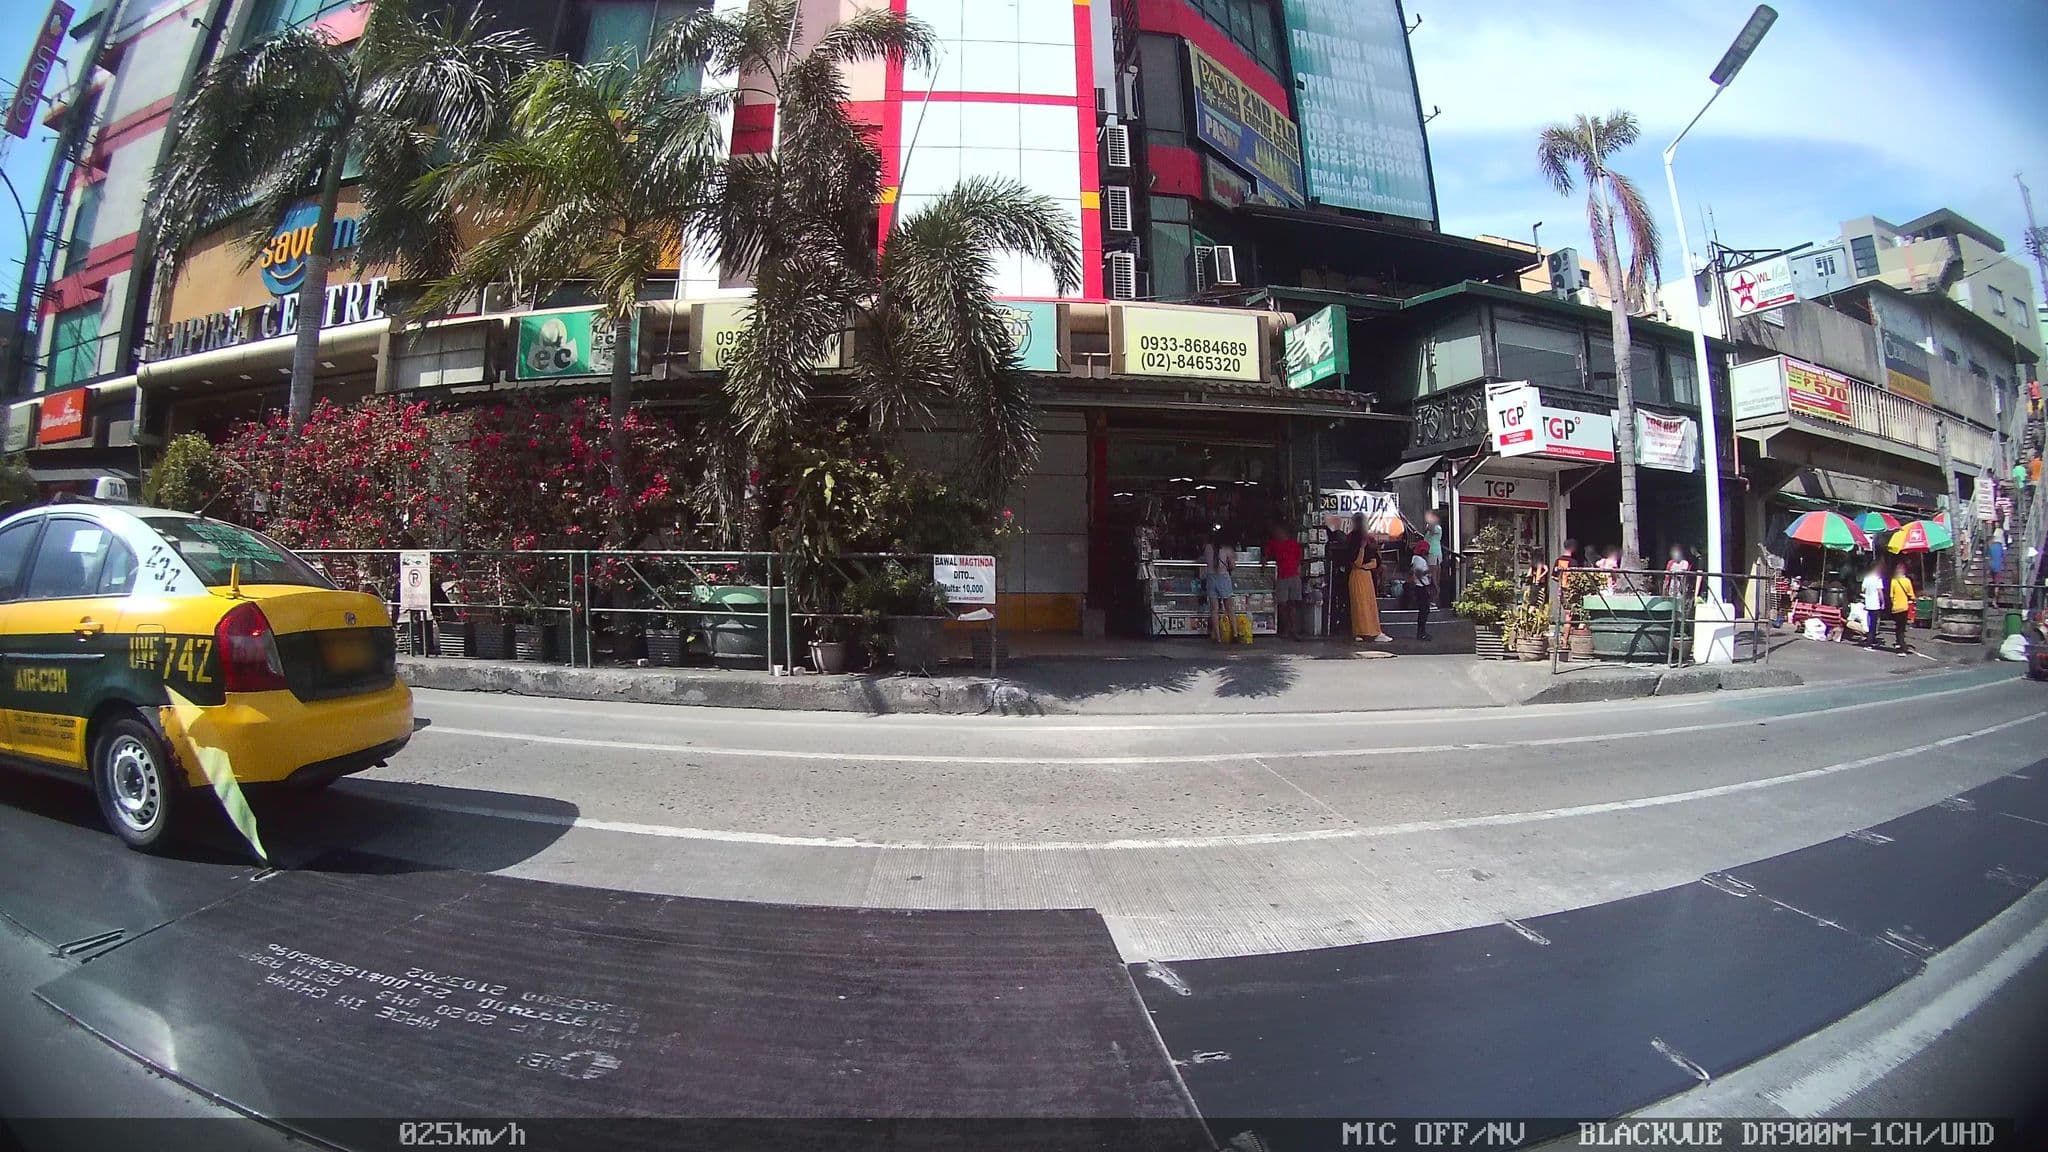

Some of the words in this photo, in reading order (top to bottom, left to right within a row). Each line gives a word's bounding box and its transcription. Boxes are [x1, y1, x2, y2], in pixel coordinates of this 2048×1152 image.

[261, 276, 389, 339] CETRE
[1140, 335, 1247, 357] 0933-8684689
[1141, 352, 1241, 372] (02)-8465320
[1814, 381, 1848, 401] 570
[1499, 406, 1524, 429] TGP
[1484, 480, 1515, 498] TGP
[1341, 495, 1368, 512] EDSA
[935, 556, 958, 567] BAWAL
[163, 637, 213, 684] 742
